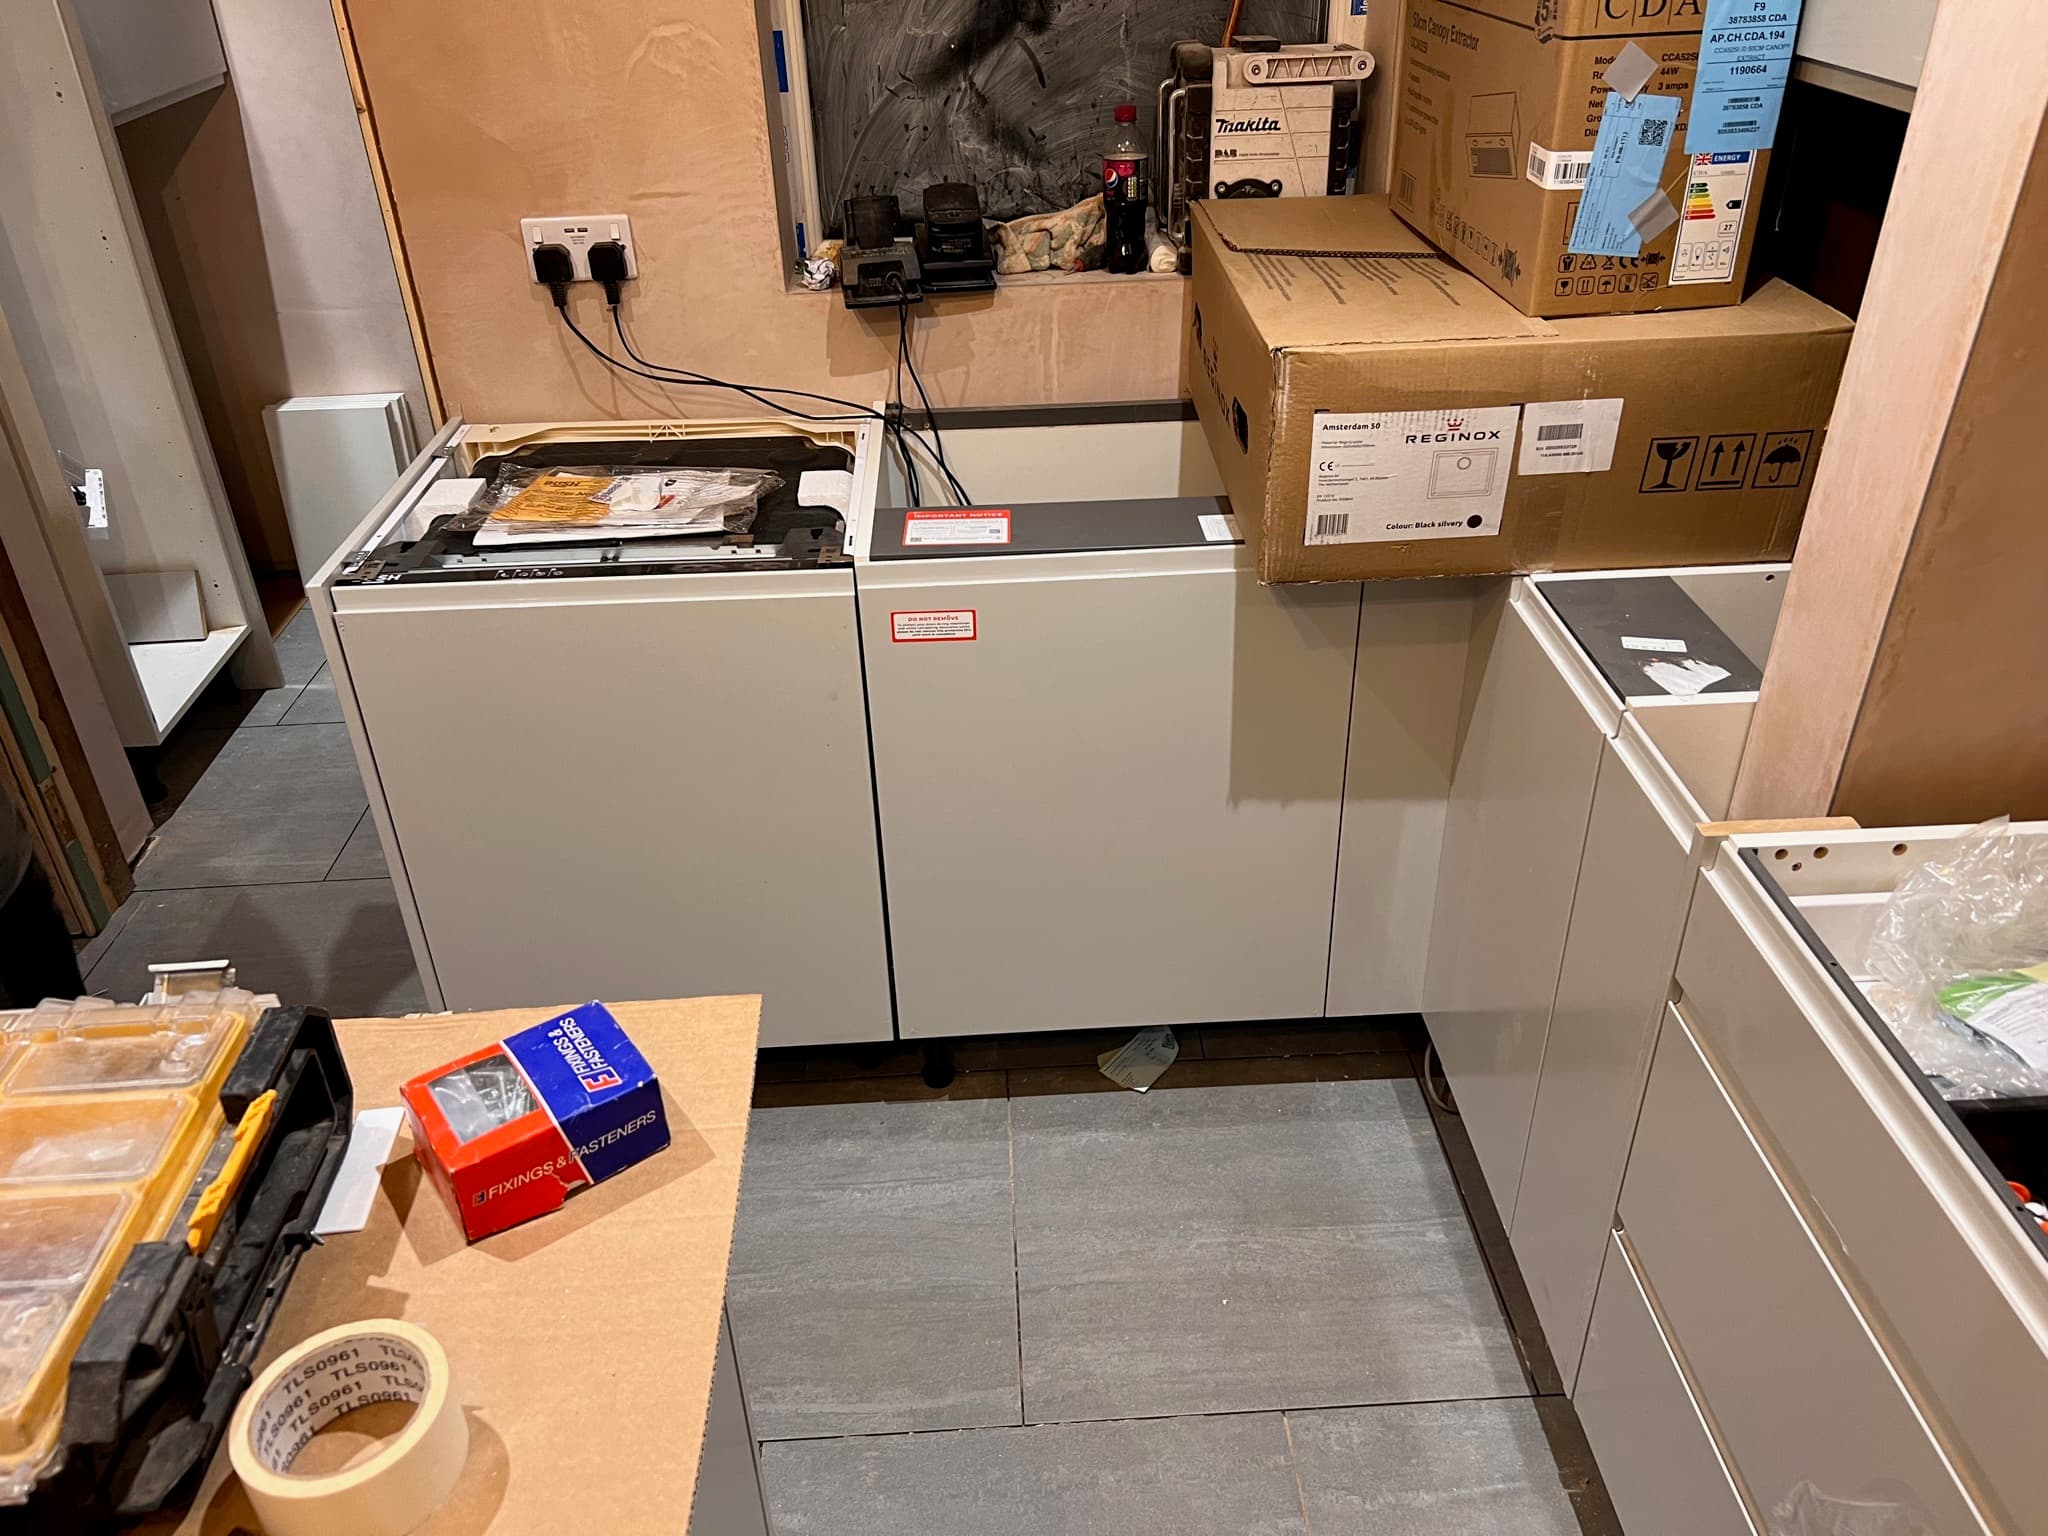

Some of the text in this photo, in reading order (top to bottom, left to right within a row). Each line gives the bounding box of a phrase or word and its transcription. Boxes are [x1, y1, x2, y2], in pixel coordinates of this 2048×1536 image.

[1753, 2, 1766, 12] F9
[1768, 13, 1787, 22] CDA
[1427, 17, 1450, 45] Canopy
[1450, 25, 1480, 51] Extractor
[1710, 30, 1785, 43] AP.CH.CDA.194
[1594, 55, 1616, 65] Mod
[1660, 67, 1679, 75] 44W
[1730, 65, 1767, 75] 1190664
[1665, 82, 1688, 91] amps
[1586, 114, 1602, 122] Gro
[1216, 117, 1281, 133] Makita
[1714, 154, 1741, 162] ENERGY
[1322, 422, 1381, 431] Amsterdam 50
[1405, 430, 1501, 444] REGINOX
[1438, 520, 1464, 528] silvery
[559, 1017, 608, 1071] FASTENERS
[553, 1034, 590, 1076] FIXINGS
[488, 1161, 554, 1200] FIXINGS
[556, 1156, 567, 1169] &
[569, 1110, 657, 1164] FASTENERS
[283, 1347, 359, 1395] TLS0961
[329, 1360, 407, 1381] TLS0961
[289, 1381, 362, 1432] TLS0961
